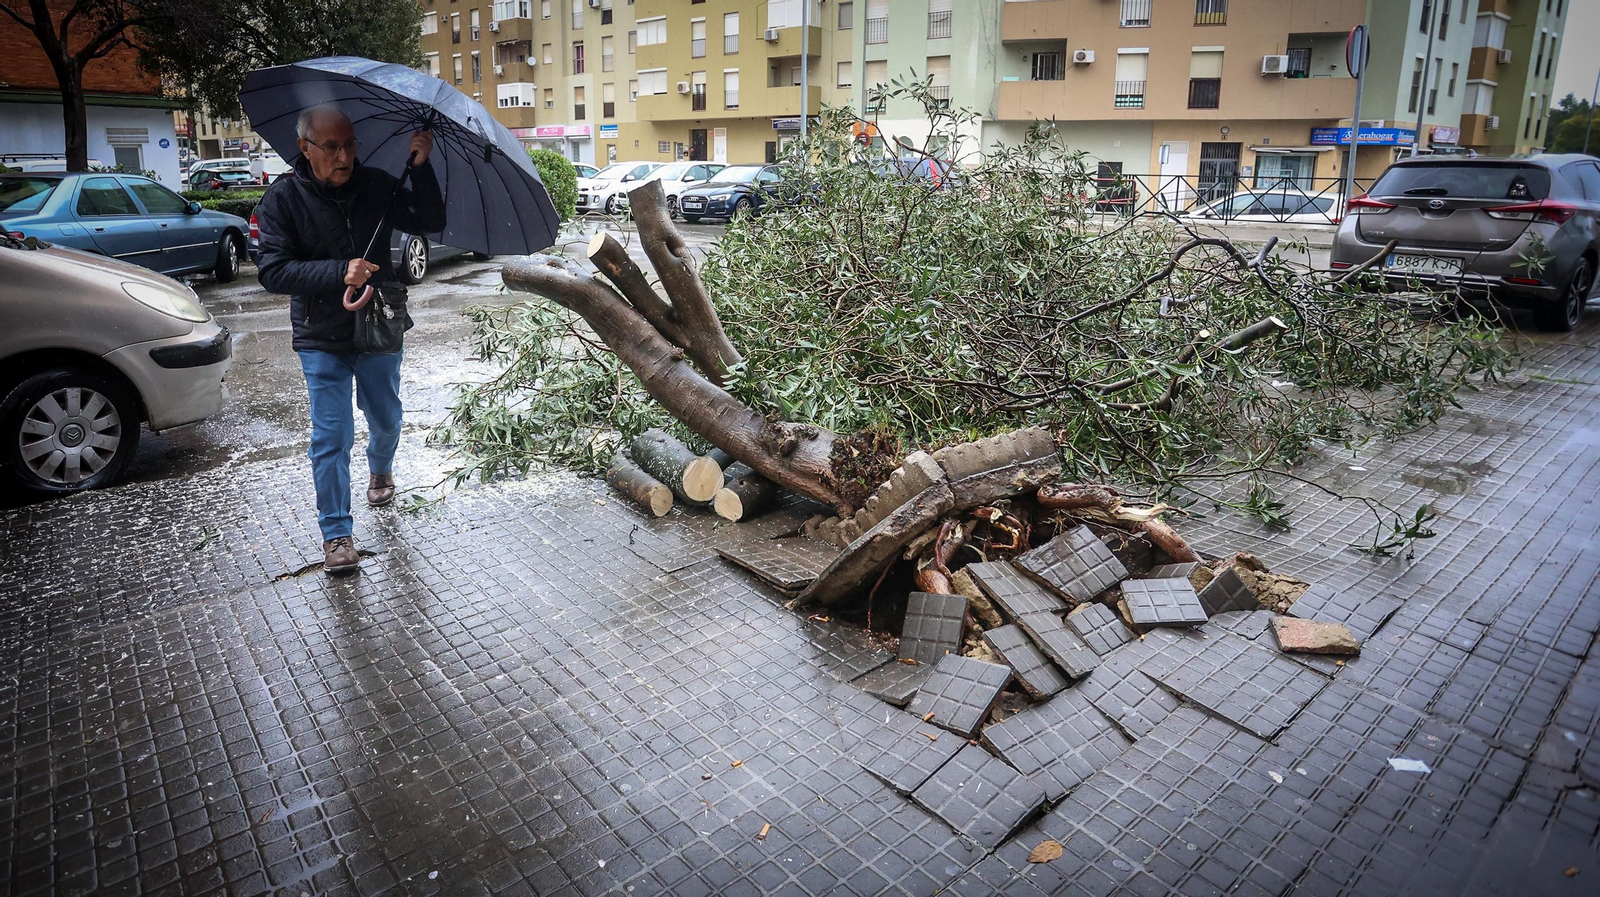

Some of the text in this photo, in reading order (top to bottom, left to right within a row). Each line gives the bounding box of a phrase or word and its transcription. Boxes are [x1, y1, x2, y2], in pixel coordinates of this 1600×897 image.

[1345, 130, 1395, 141] Serahogar
[1396, 256, 1458, 270] 6887 KJP
